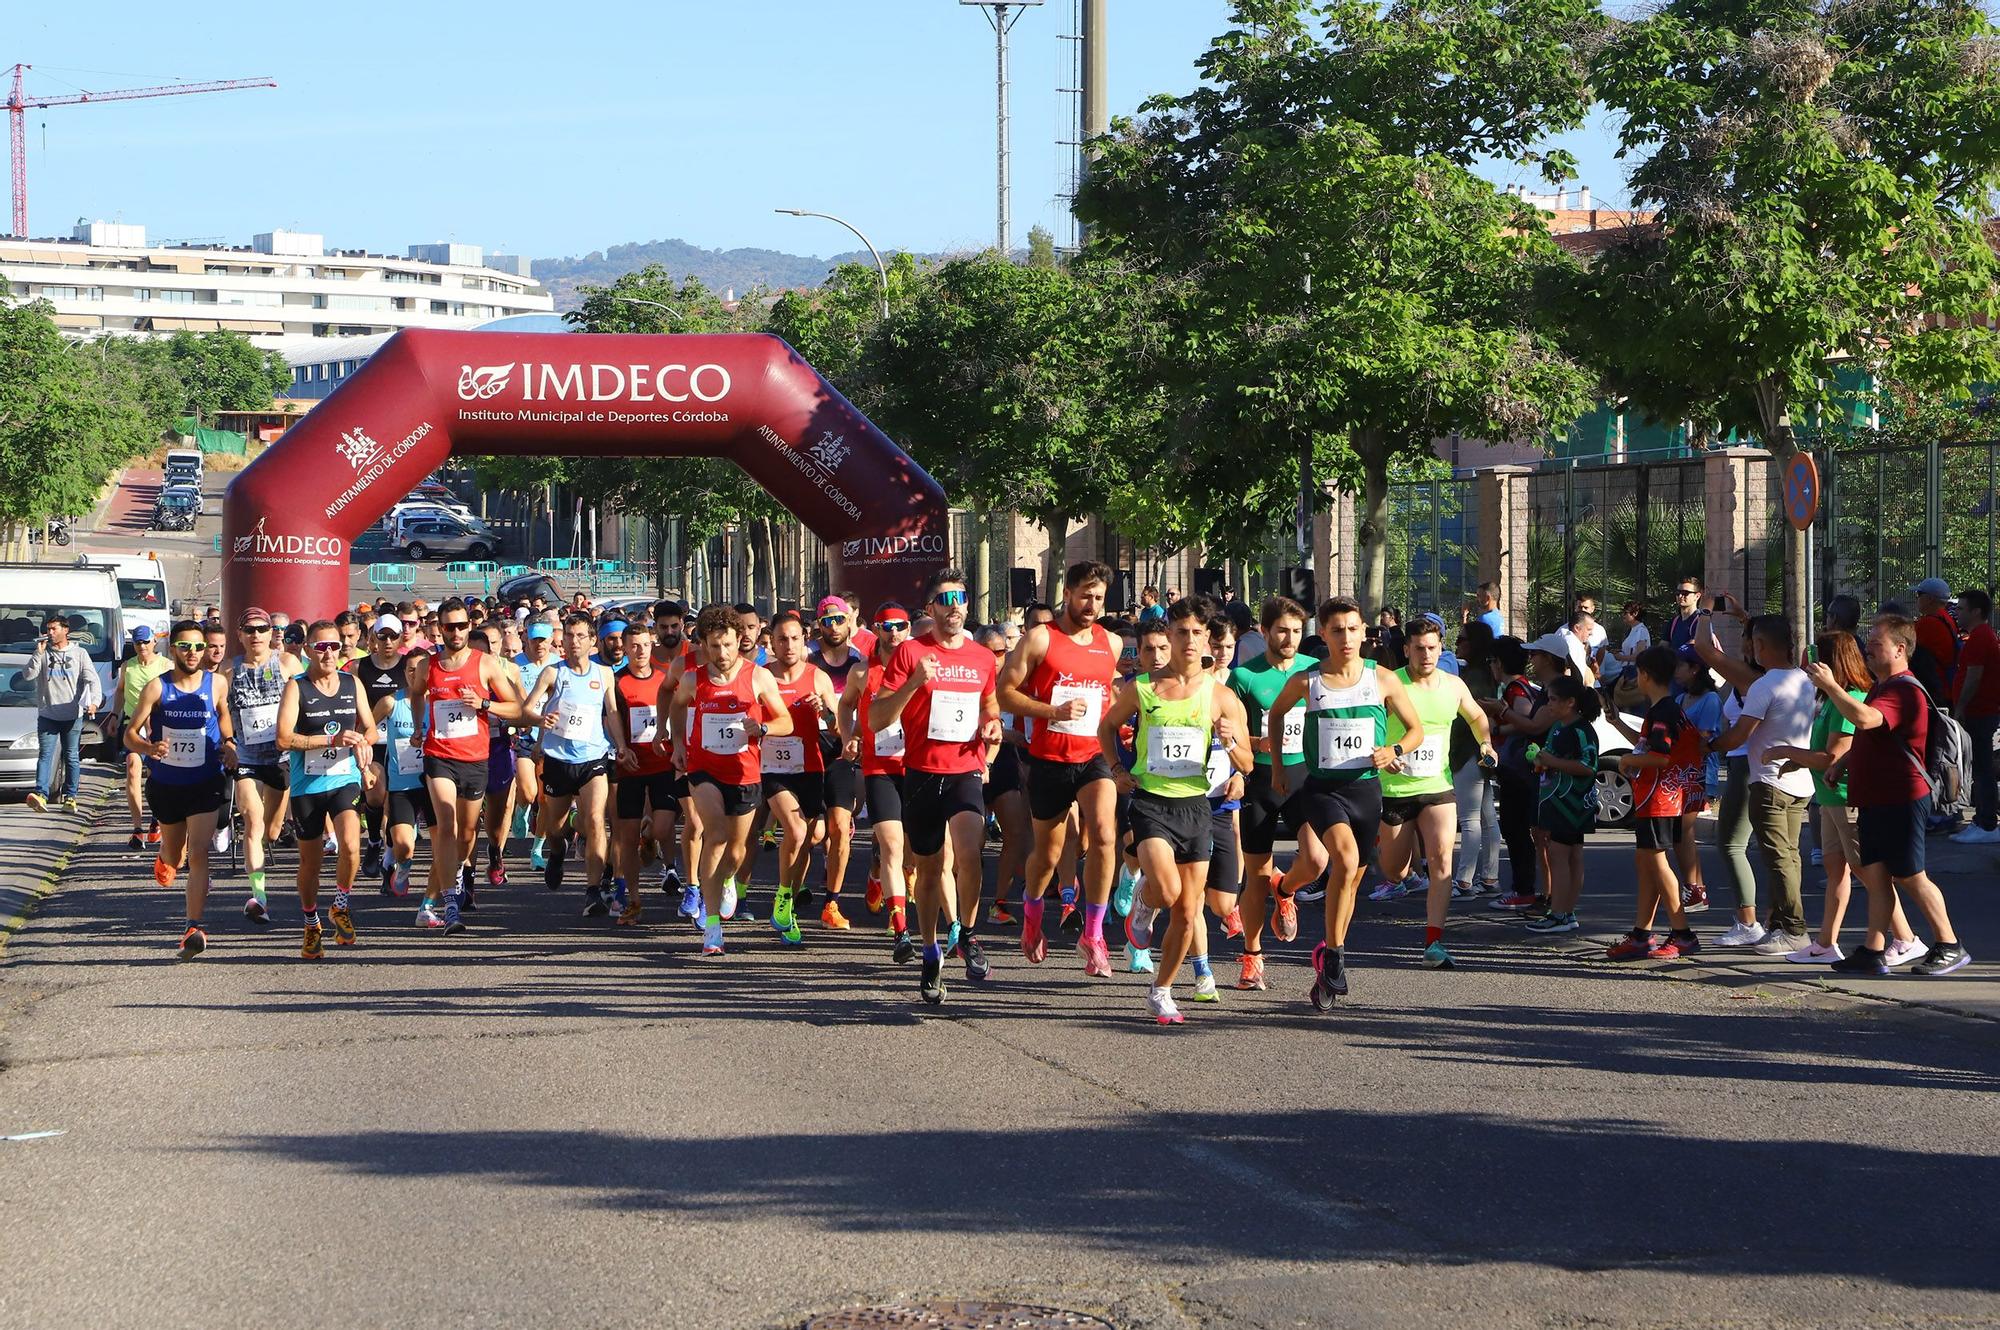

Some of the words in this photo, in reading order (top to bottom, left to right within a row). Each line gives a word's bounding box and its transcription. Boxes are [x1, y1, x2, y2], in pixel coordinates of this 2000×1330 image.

[522, 363, 732, 402] IMDECO
[458, 409, 513, 421] Instituto
[518, 410, 583, 423] Municipal
[587, 411, 604, 422] de
[608, 411, 669, 424] Deportes
[673, 410, 729, 423] Córdoba
[324, 464, 384, 519] AYUNTAMIENTO
[381, 453, 396, 469] DE
[392, 421, 433, 458] CÓRDOBA
[757, 424, 816, 478] AYUNTAMIENTO
[813, 474, 828, 488] DE
[824, 484, 862, 521] CÓRDOBA
[256, 535, 342, 556] IMDECO
[864, 535, 944, 555] IMDECO
[254, 556, 284, 564] Municipal
[937, 665, 978, 679] califas
[448, 712, 462, 723] 34
[568, 715, 583, 726] 85
[955, 709, 964, 722] 3
[252, 717, 273, 730] 436
[642, 718, 656, 728] 14
[1285, 723, 1302, 736] 38
[718, 728, 734, 739] 13
[173, 742, 195, 752] 173
[1334, 735, 1362, 749] 140
[322, 748, 337, 760] 49
[776, 750, 791, 760] 33
[1163, 744, 1191, 758] 137
[1413, 750, 1434, 761] 139
